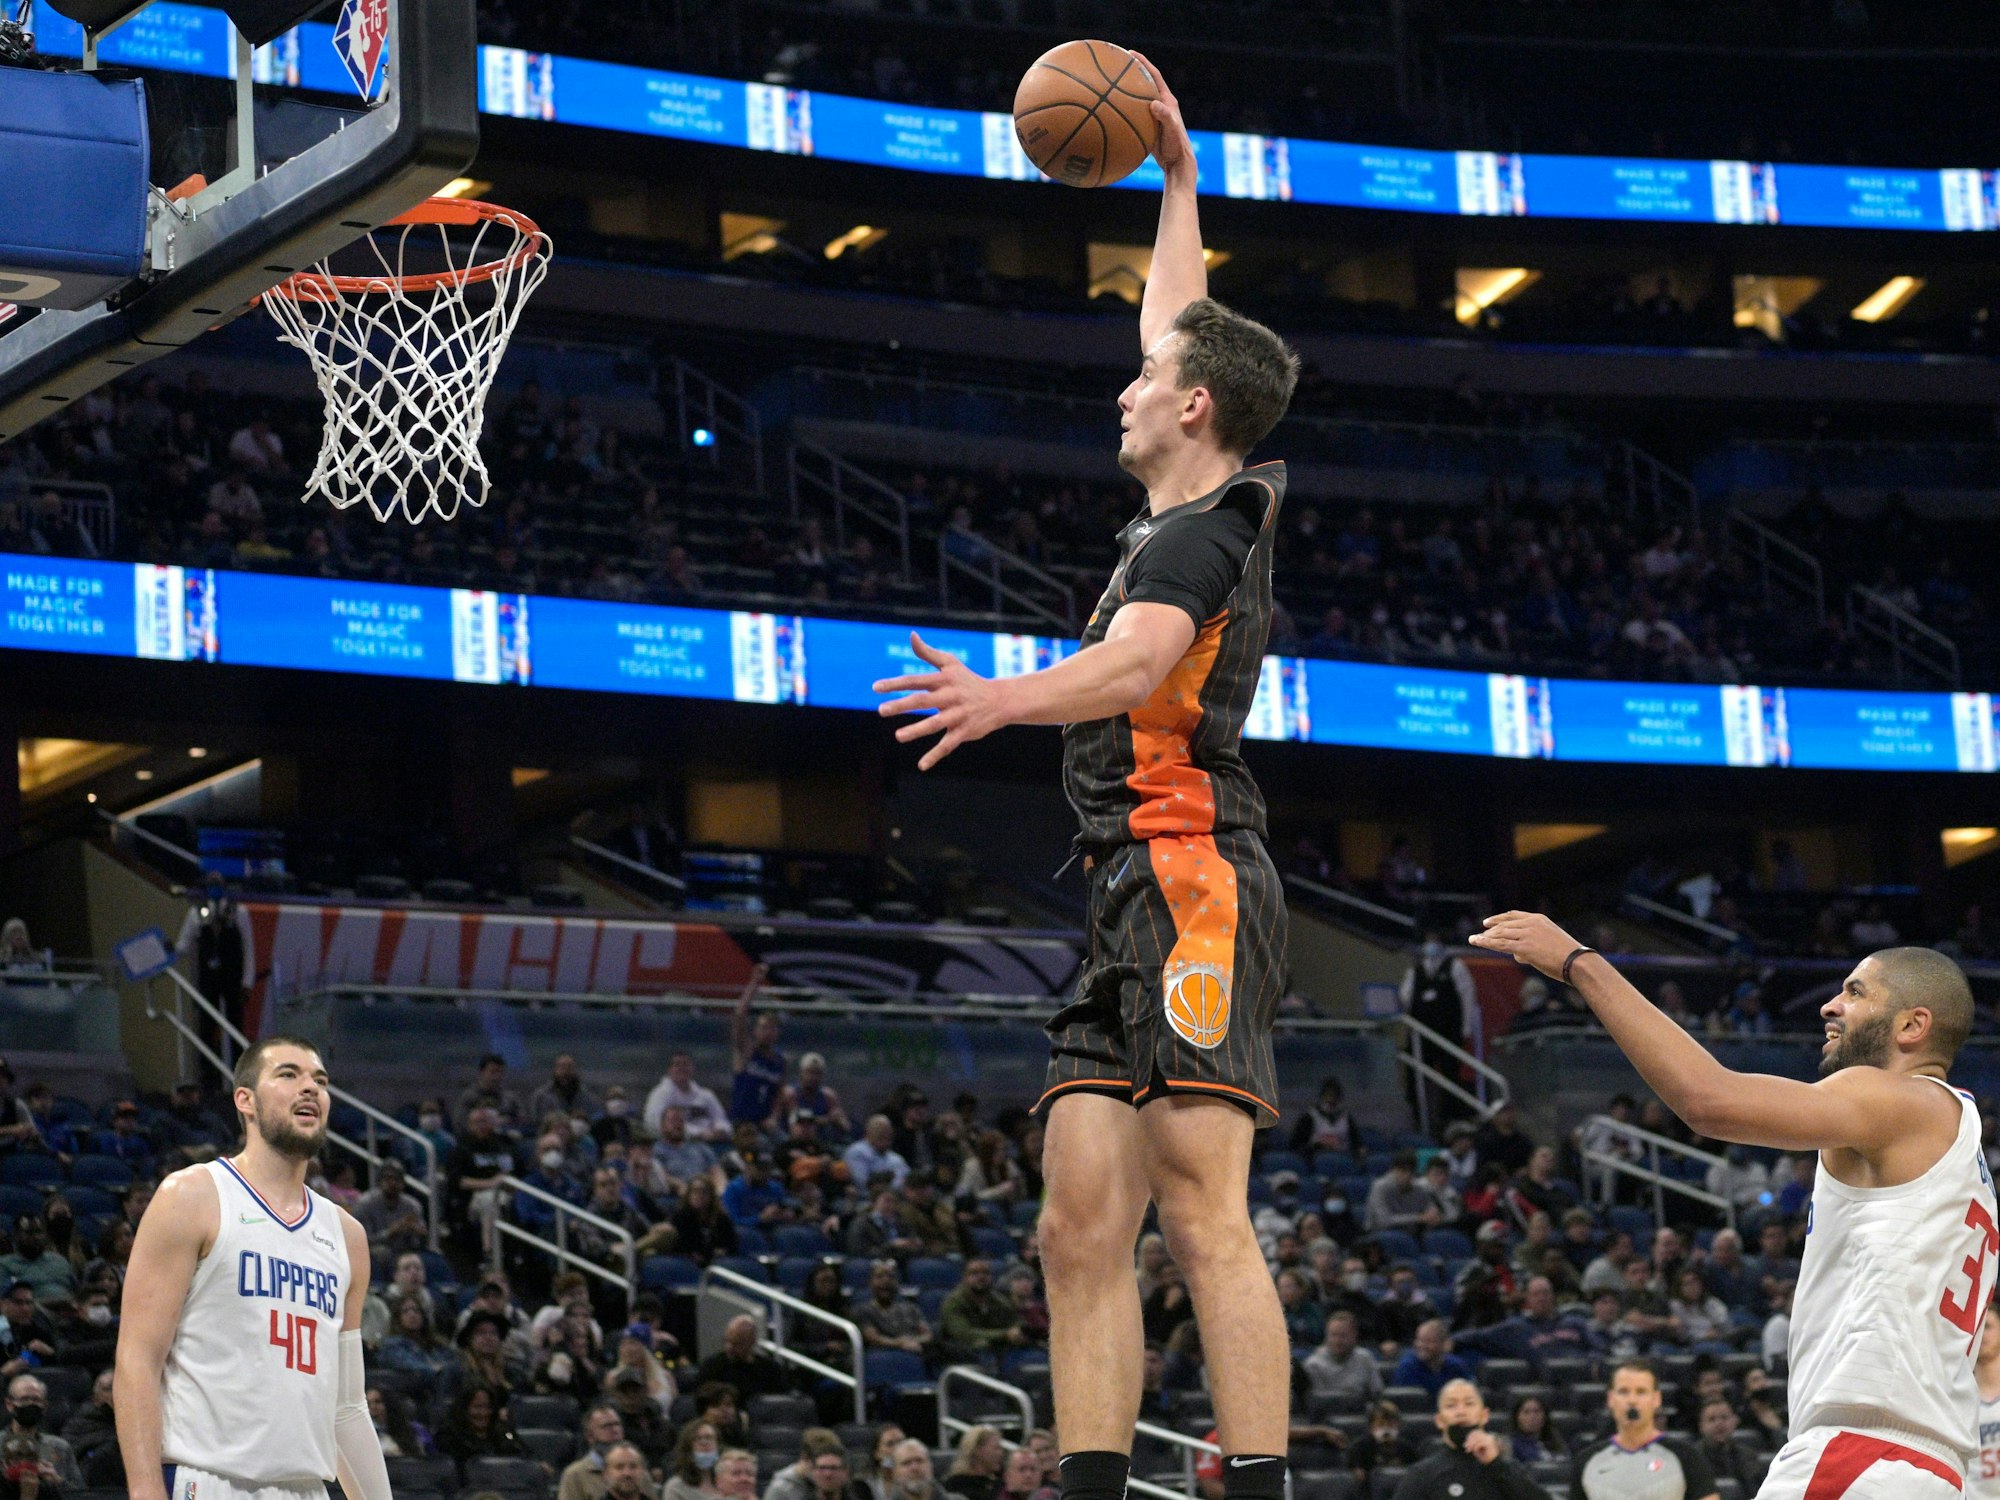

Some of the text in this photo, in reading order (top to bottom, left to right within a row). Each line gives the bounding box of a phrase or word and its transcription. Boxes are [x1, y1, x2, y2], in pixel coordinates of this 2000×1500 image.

[8, 572, 103, 596] MADE FOR
[24, 595, 85, 614] MAGIC
[331, 599, 421, 620] MADE FOR
[8, 613, 104, 635] TOGETHER
[348, 620, 404, 639] MAGIC
[333, 638, 423, 659] TOGETHER
[238, 1249, 338, 1319] CLIPPERS
[269, 1309, 318, 1376] 40
